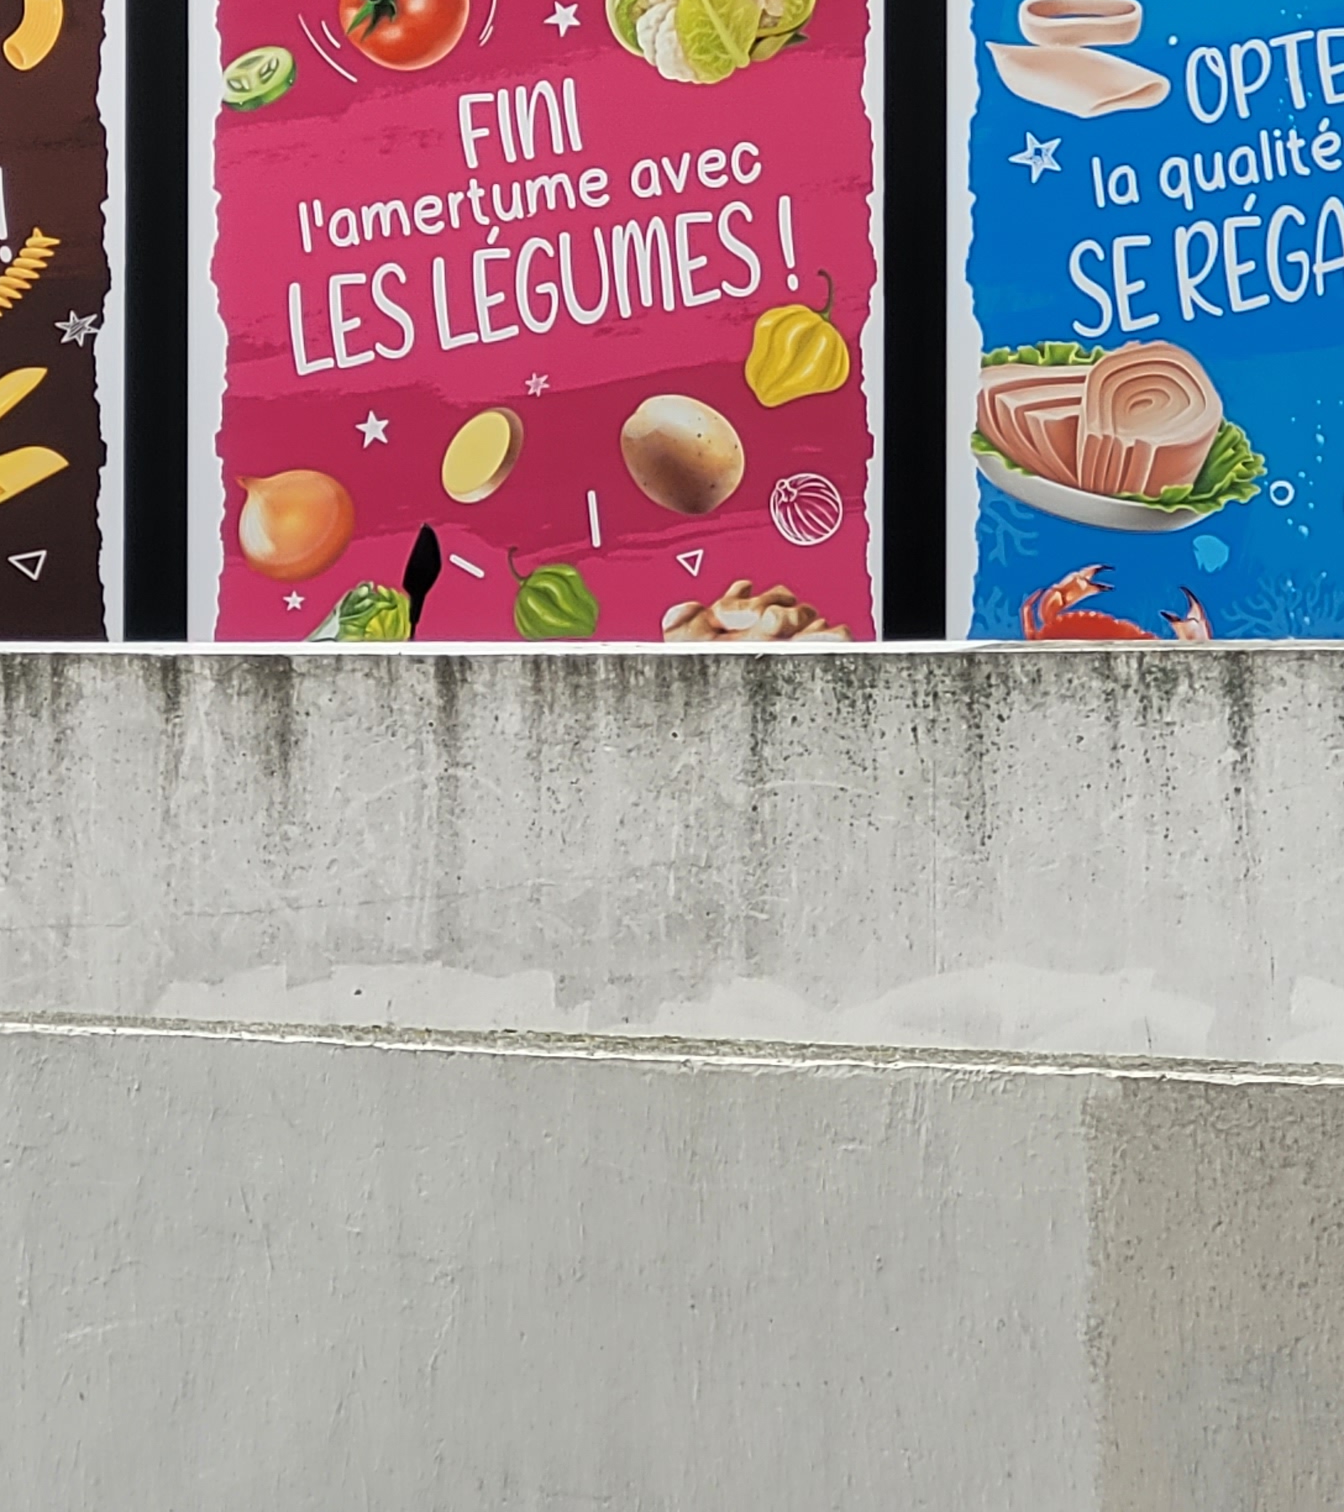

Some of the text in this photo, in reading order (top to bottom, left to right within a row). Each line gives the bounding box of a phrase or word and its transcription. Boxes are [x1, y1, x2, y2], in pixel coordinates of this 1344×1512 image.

[458, 77, 584, 169] FINI
[1092, 157, 1139, 208] la
[1159, 118, 1343, 210] qualité
[298, 141, 763, 253] l'amertume avec
[288, 262, 415, 376] LES
[432, 201, 762, 351] LÉGUMES
[1069, 235, 1159, 337] SE
